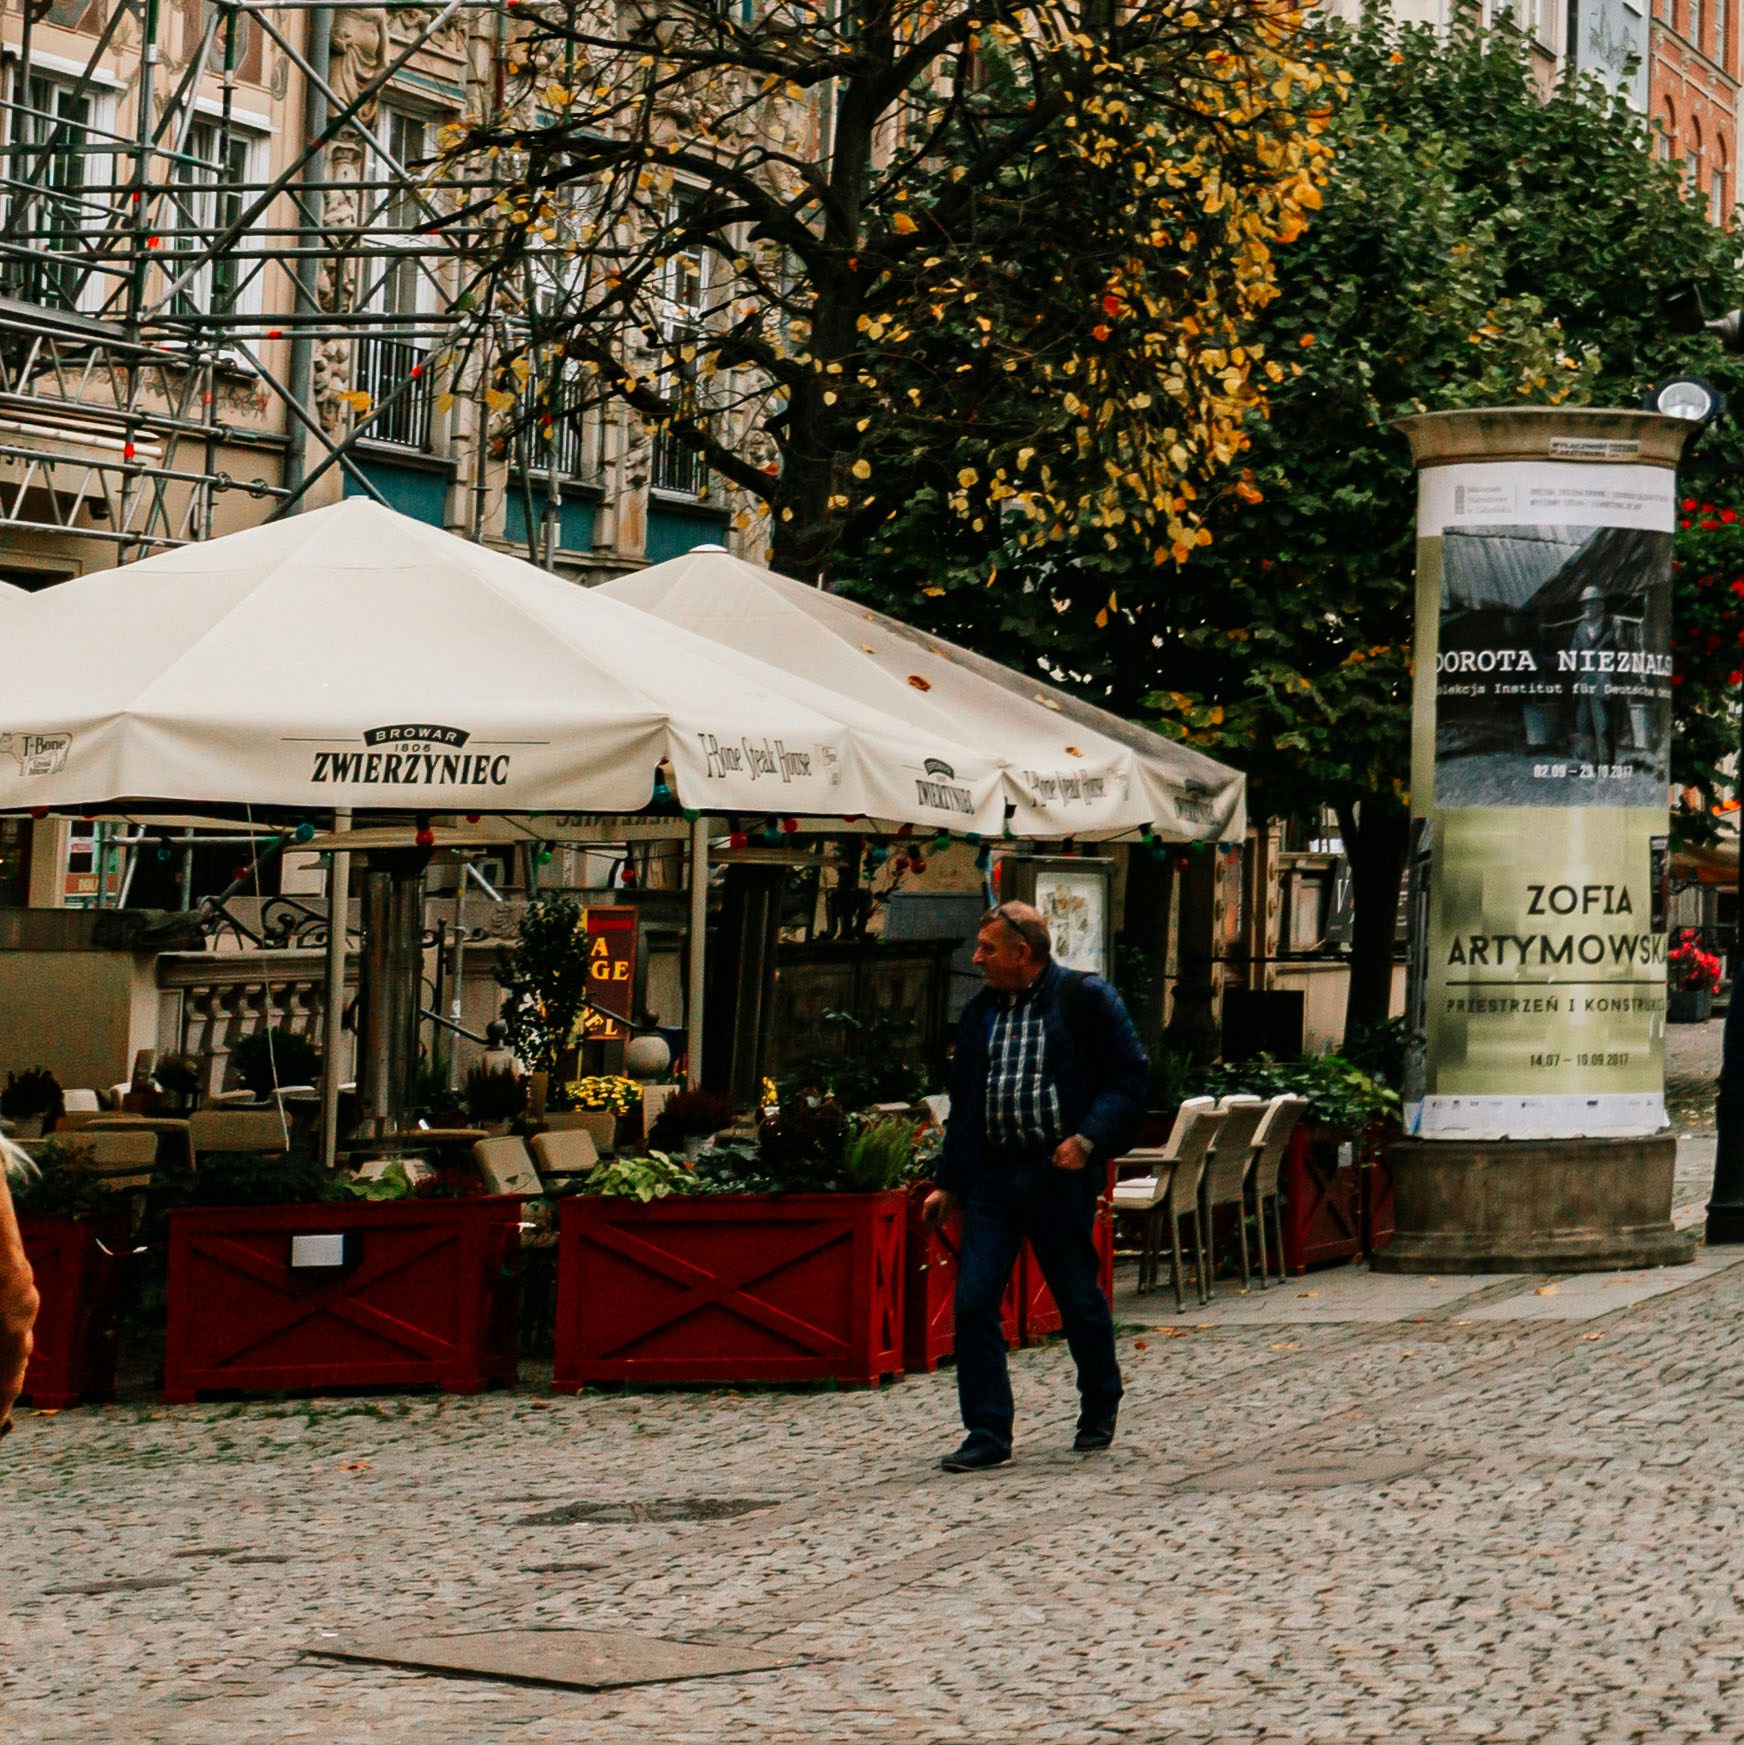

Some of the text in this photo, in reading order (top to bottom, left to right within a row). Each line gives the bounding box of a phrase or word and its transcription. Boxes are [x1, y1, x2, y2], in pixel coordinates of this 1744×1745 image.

[1495, 682, 1563, 694] Institut
[1573, 683, 1597, 694] für
[375, 727, 457, 742] BROWAR
[22, 736, 66, 757] T-Bone
[394, 743, 431, 752] 1806
[311, 752, 510, 785] ZWIERZYNIEC
[774, 740, 812, 783] House
[1526, 885, 1633, 915] ZOFIA
[1447, 993, 1559, 1013] PRZESTRZEŃ
[1568, 998, 1575, 1012] I
